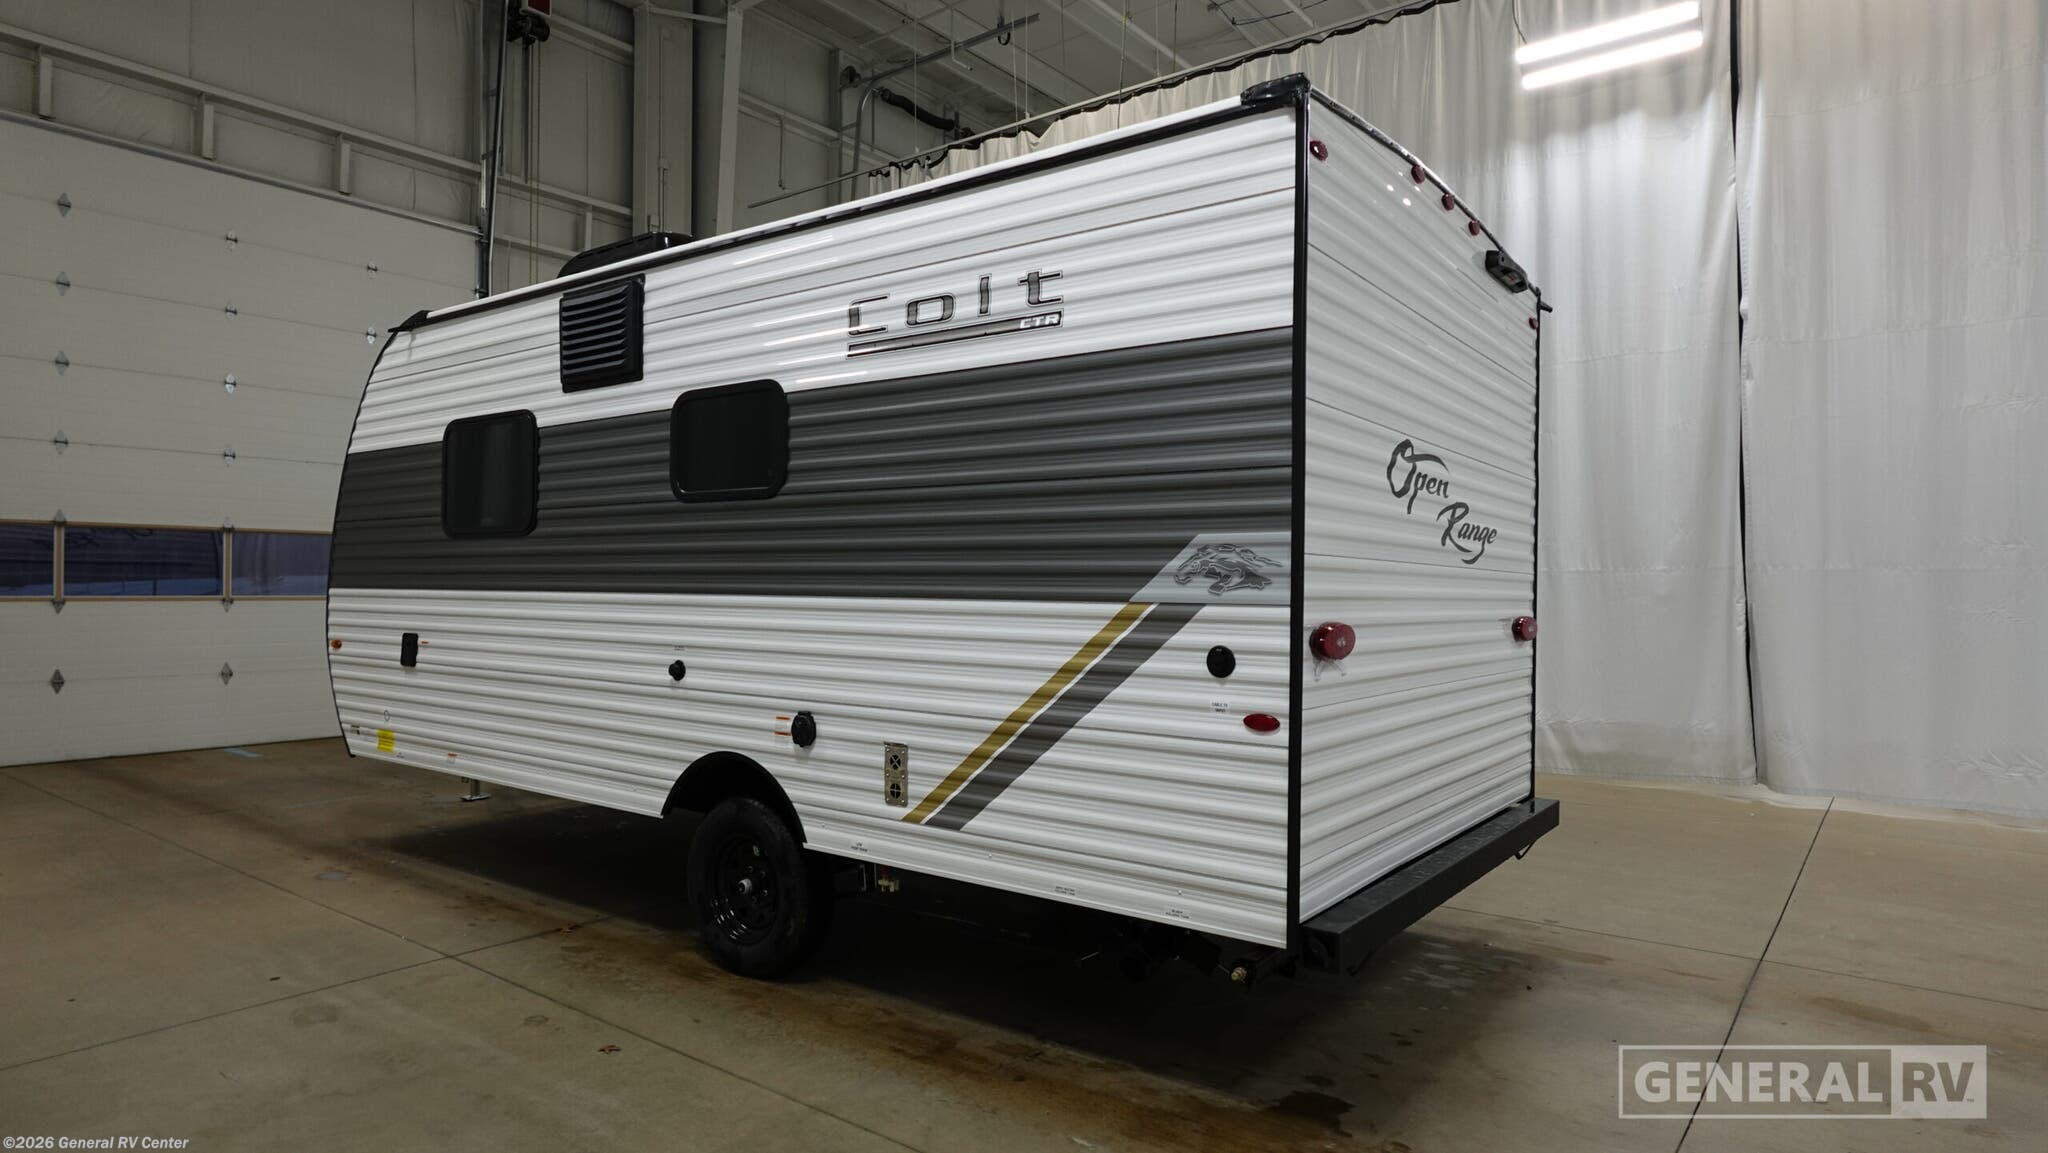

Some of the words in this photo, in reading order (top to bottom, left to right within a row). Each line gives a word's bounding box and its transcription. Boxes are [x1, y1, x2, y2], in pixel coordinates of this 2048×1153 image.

[1019, 314, 1059, 329] CTR
[1387, 439, 1449, 514] Open
[1436, 502, 1497, 564] Range
